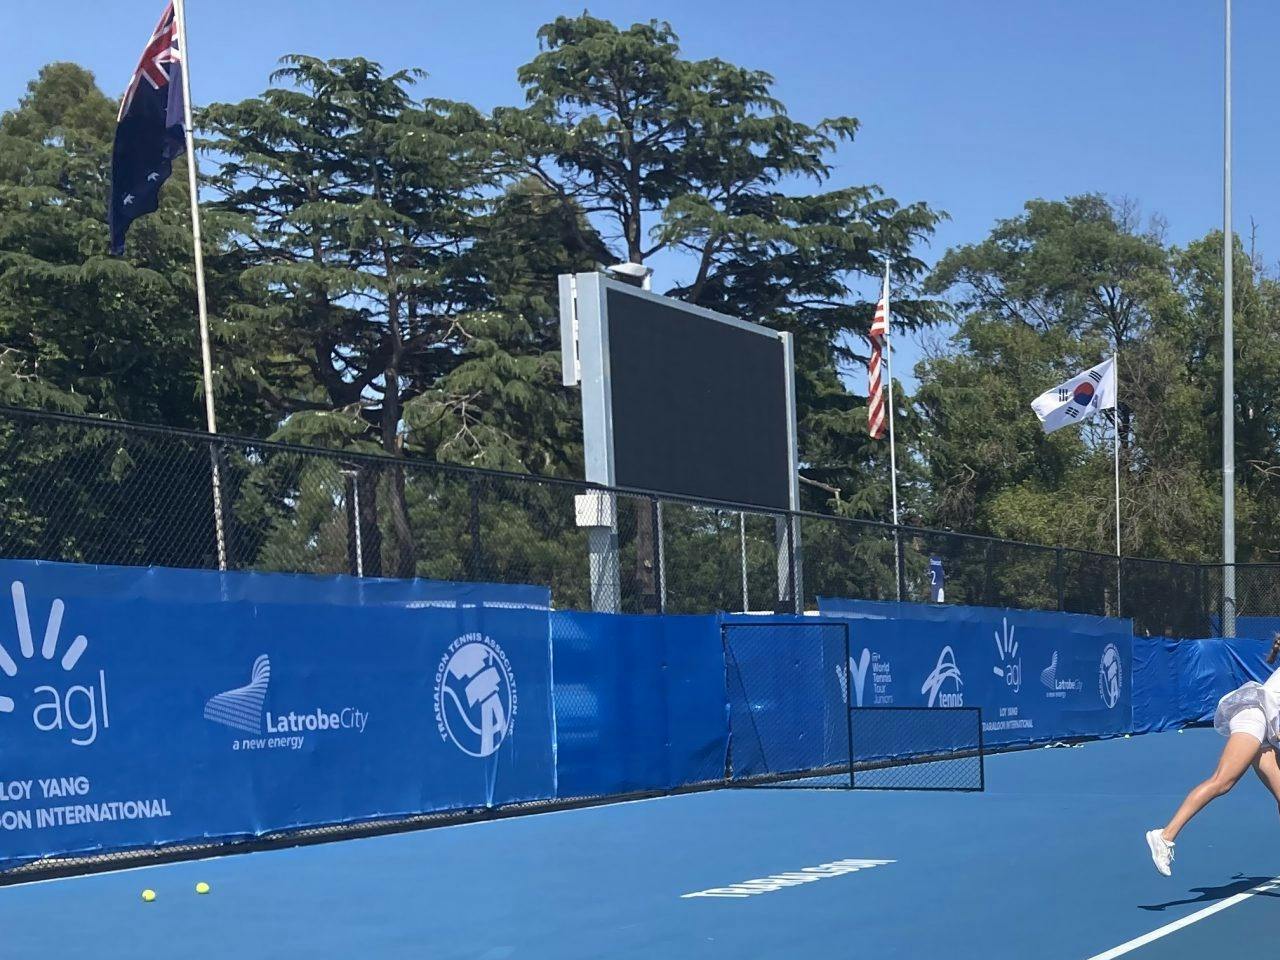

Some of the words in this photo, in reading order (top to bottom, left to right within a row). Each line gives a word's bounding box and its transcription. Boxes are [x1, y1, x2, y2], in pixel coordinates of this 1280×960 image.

[434, 652, 450, 743] TRARALGON
[448, 632, 483, 654] TENNIS
[484, 635, 518, 716] ASSOCIATION
[1006, 656, 1022, 693] agl
[33, 669, 109, 746] agl
[939, 690, 964, 707] tennis
[266, 706, 369, 733] LatrobeCity
[232, 739, 240, 751] a
[242, 738, 267, 750] new
[267, 735, 305, 750] energy
[0, 780, 33, 801] LOY
[38, 776, 90, 798] YANG
[0, 810, 33, 831] ON
[36, 798, 172, 829] INTERNATIONAL
